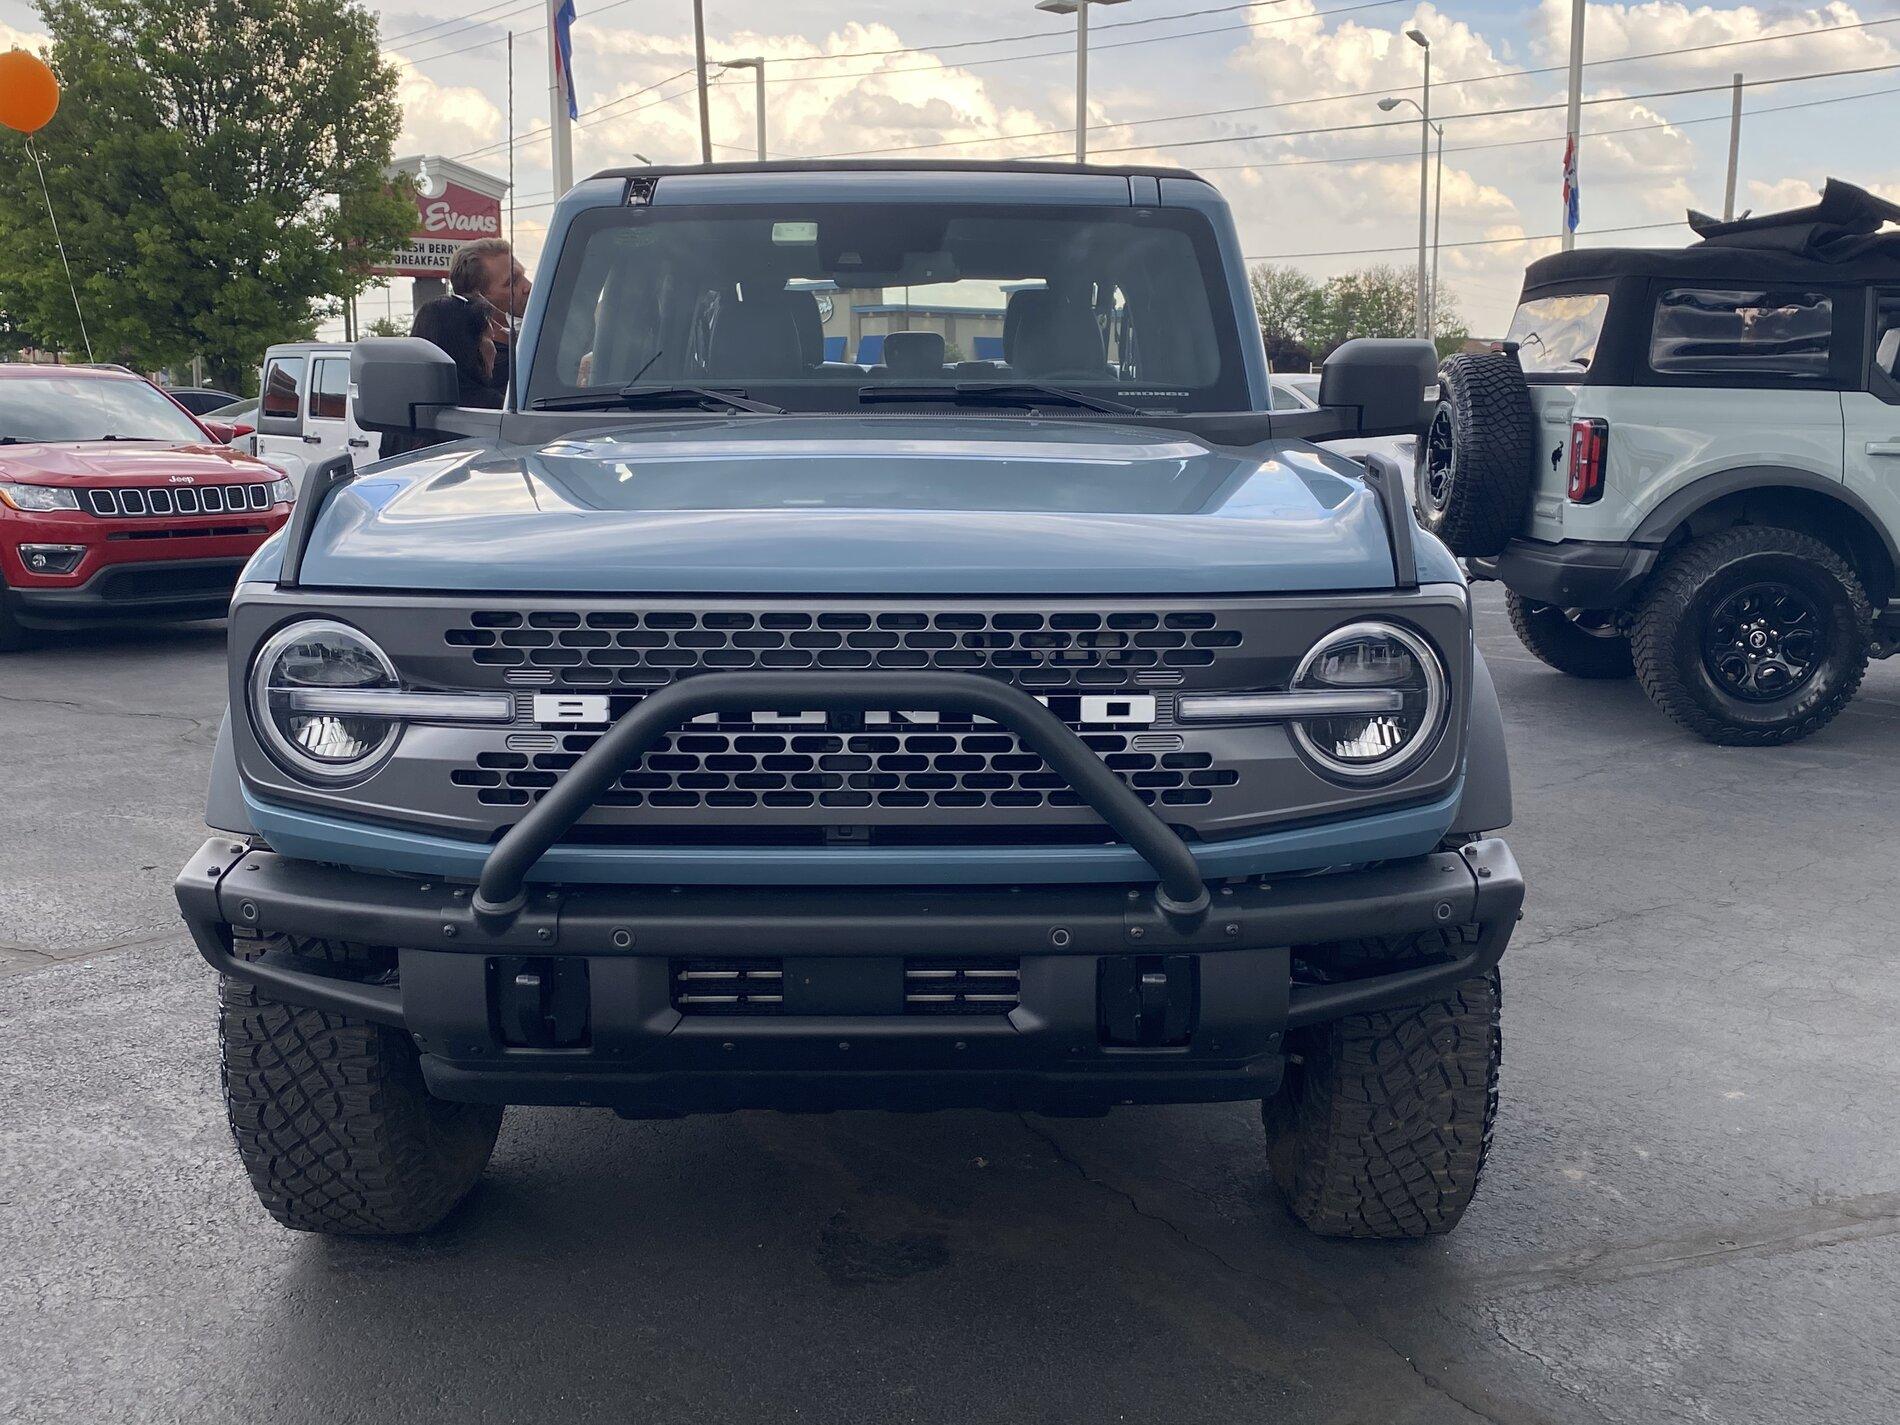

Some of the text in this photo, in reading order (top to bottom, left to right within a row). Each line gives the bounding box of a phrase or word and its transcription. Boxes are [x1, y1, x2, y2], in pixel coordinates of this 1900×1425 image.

[425, 202, 498, 233] Evans
[395, 255, 450, 266] BREAKFAST
[168, 475, 195, 484] Jeep
